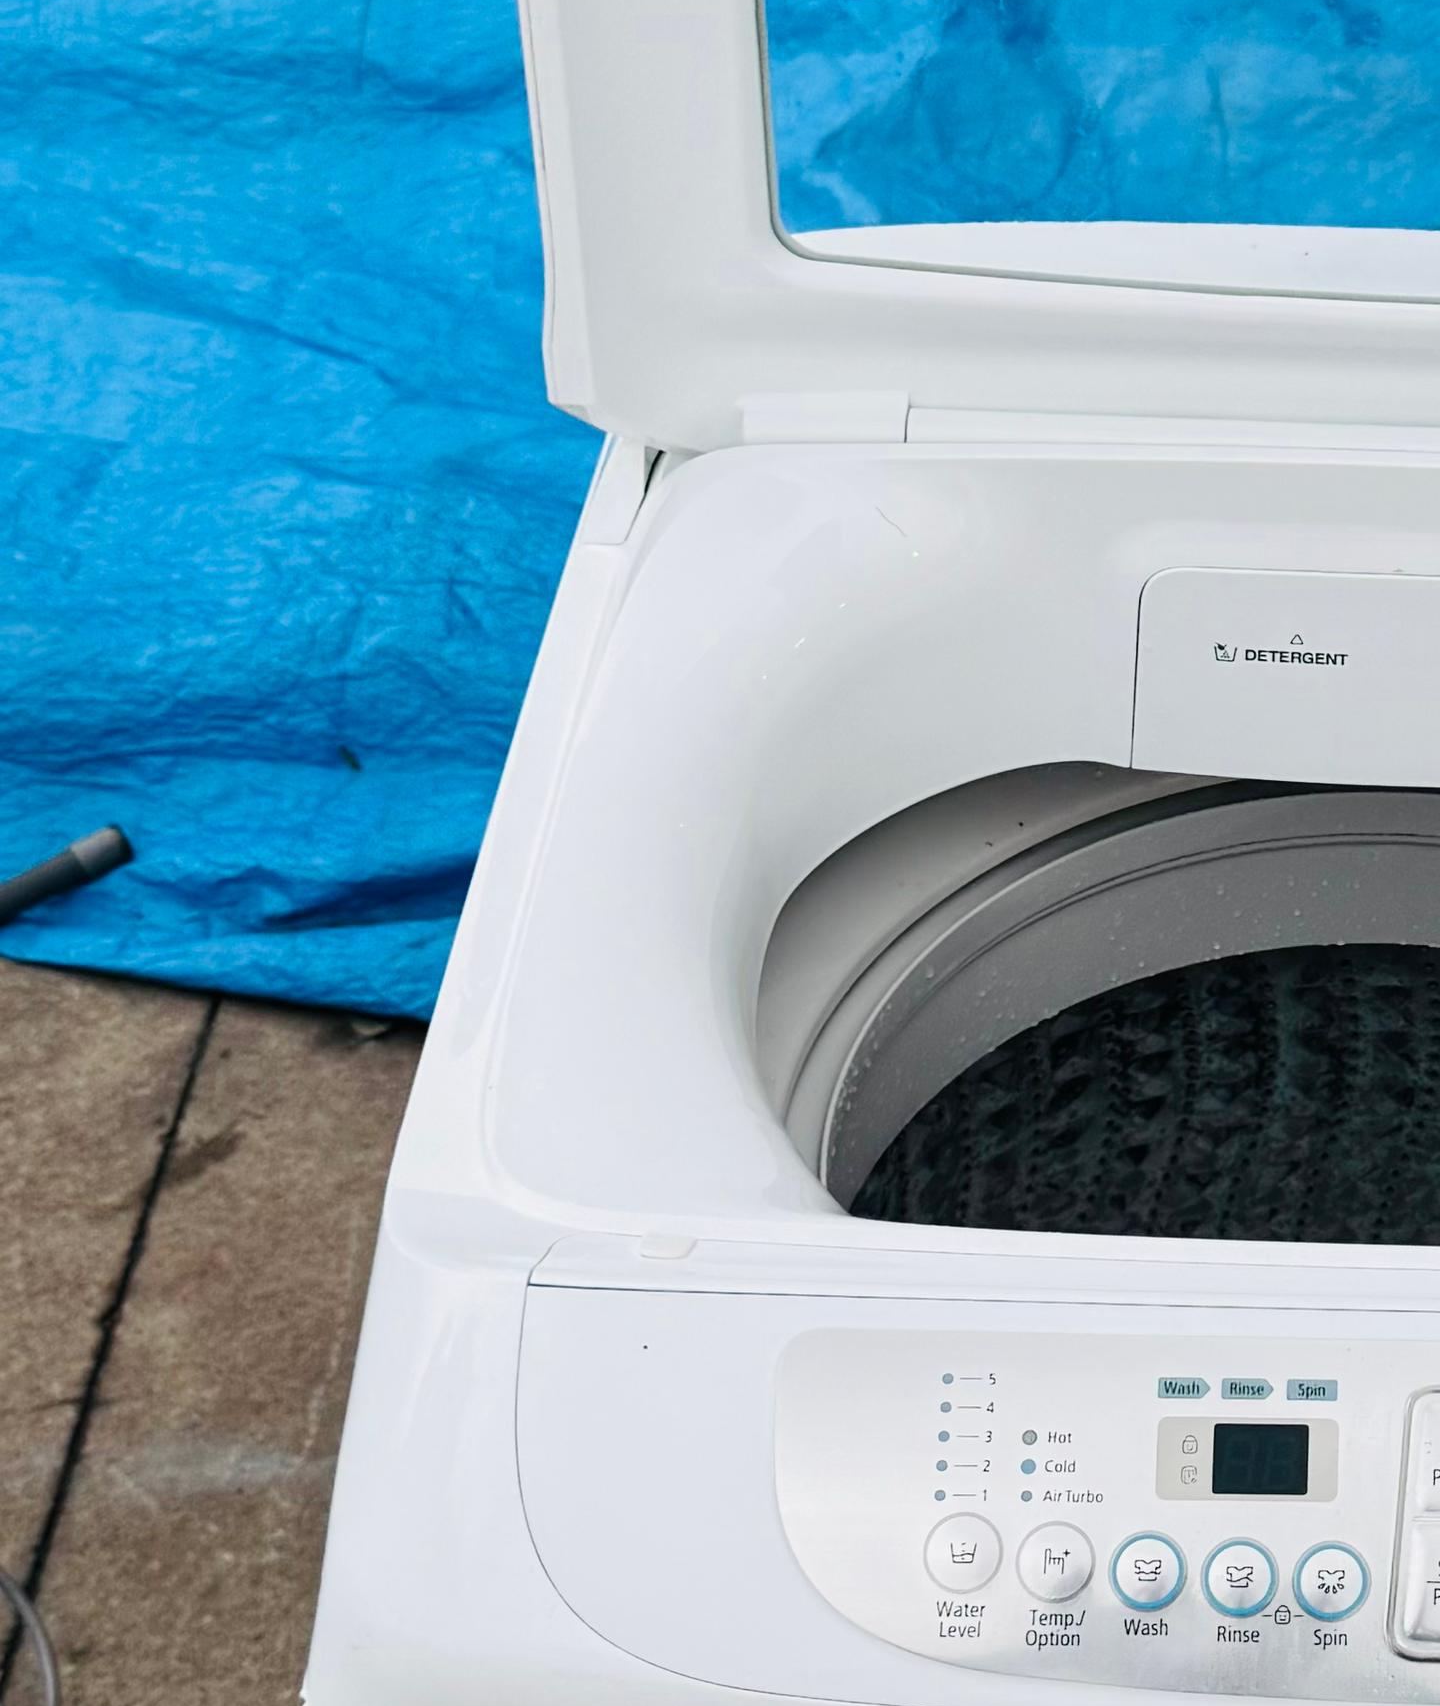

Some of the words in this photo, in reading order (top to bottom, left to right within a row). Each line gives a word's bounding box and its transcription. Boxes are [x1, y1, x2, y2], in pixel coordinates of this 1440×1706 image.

[1244, 649, 1349, 666] DETERGENT
[988, 1372, 997, 1386] 5
[1163, 1380, 1200, 1396] Wash
[1229, 1381, 1265, 1396] Rinse
[1297, 1383, 1326, 1400] Spin
[986, 1401, 995, 1414] 4
[984, 1430, 993, 1444] 3
[1047, 1431, 1072, 1444] Hot
[982, 1459, 991, 1473] 2
[1044, 1459, 1076, 1473] Cold
[982, 1488, 988, 1502] 1
[1042, 1490, 1063, 1503] Air
[1066, 1489, 1104, 1504] Turbo
[936, 1600, 986, 1618] Water
[1029, 1609, 1086, 1628] Temp./
[939, 1620, 981, 1638] Level
[1123, 1617, 1169, 1637] Wash
[1216, 1625, 1261, 1644] Rinse
[1025, 1629, 1081, 1652] Option
[1313, 1628, 1348, 1651] Spin
